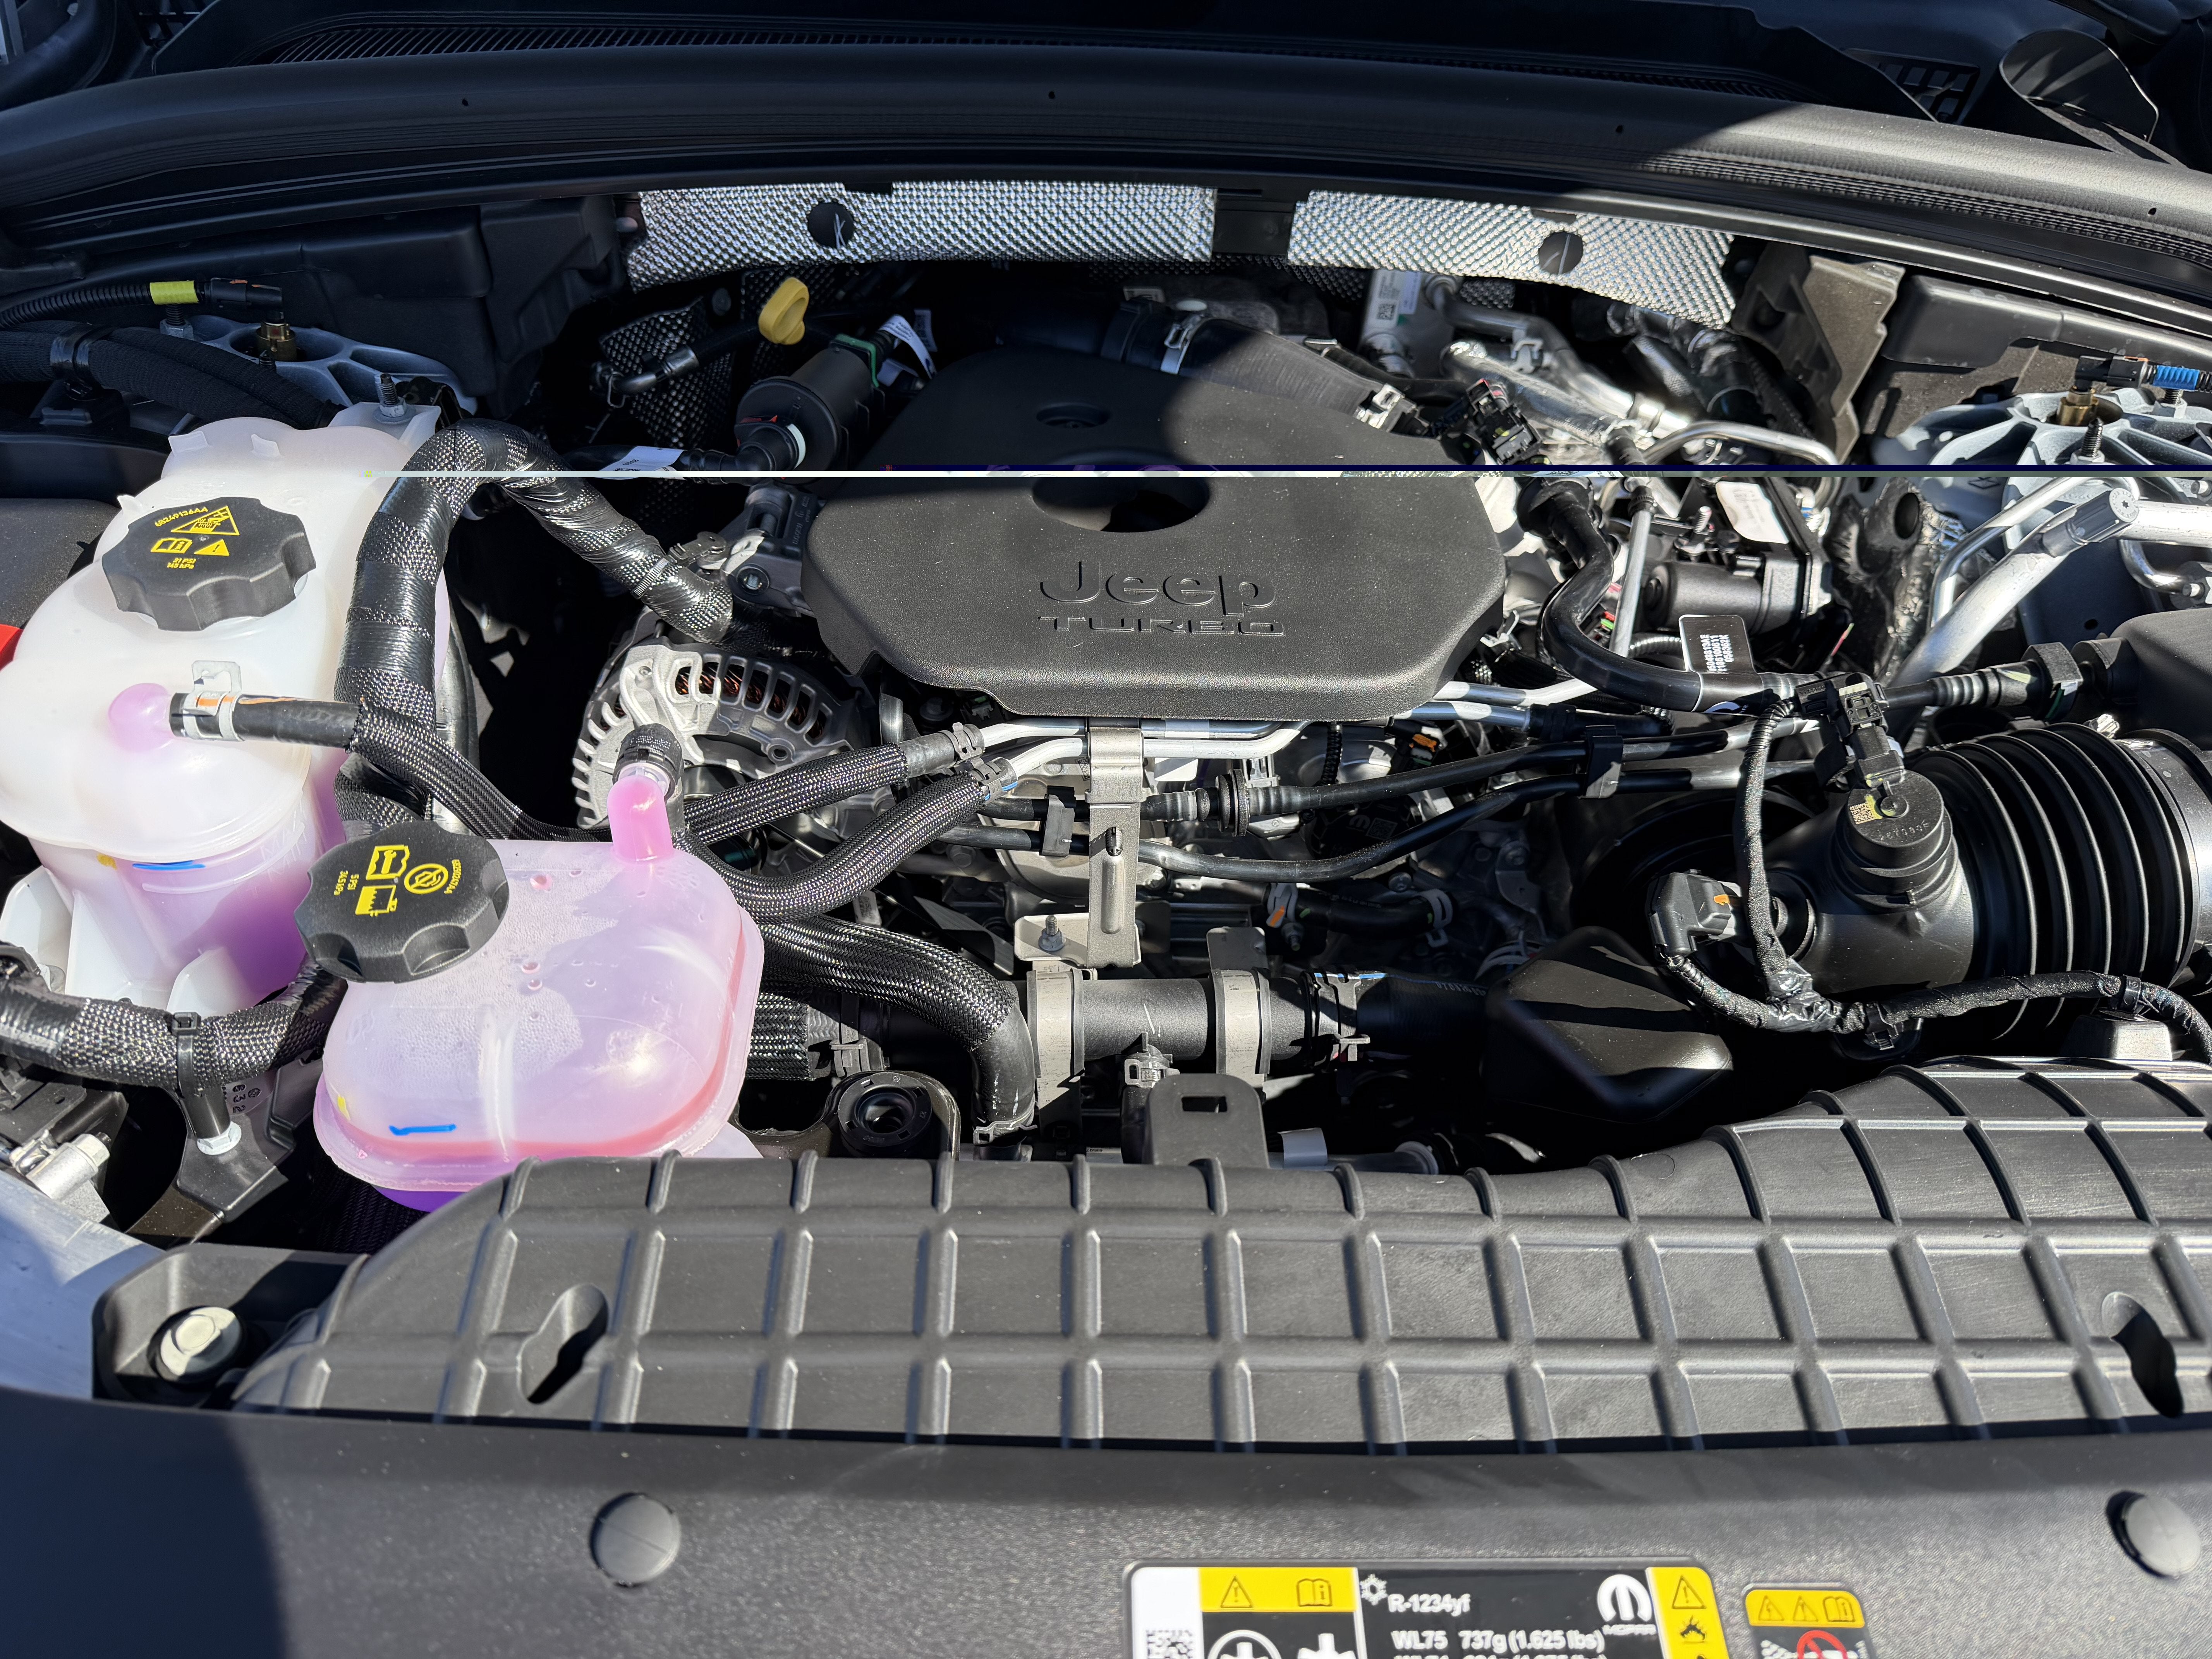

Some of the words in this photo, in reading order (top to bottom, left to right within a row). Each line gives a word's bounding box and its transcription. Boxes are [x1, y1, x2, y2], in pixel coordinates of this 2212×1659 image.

[1040, 561, 1276, 617] Jeep
[1039, 617, 1284, 636] TURBO
[347, 879, 359, 890] PSI
[1388, 1593, 1471, 1616] R-1234yf
[1391, 1630, 1448, 1650] WL75
[1458, 1630, 1508, 1654] 737g
[1509, 1630, 1566, 1654] (1.625
[1566, 1629, 1606, 1654] lbs)
